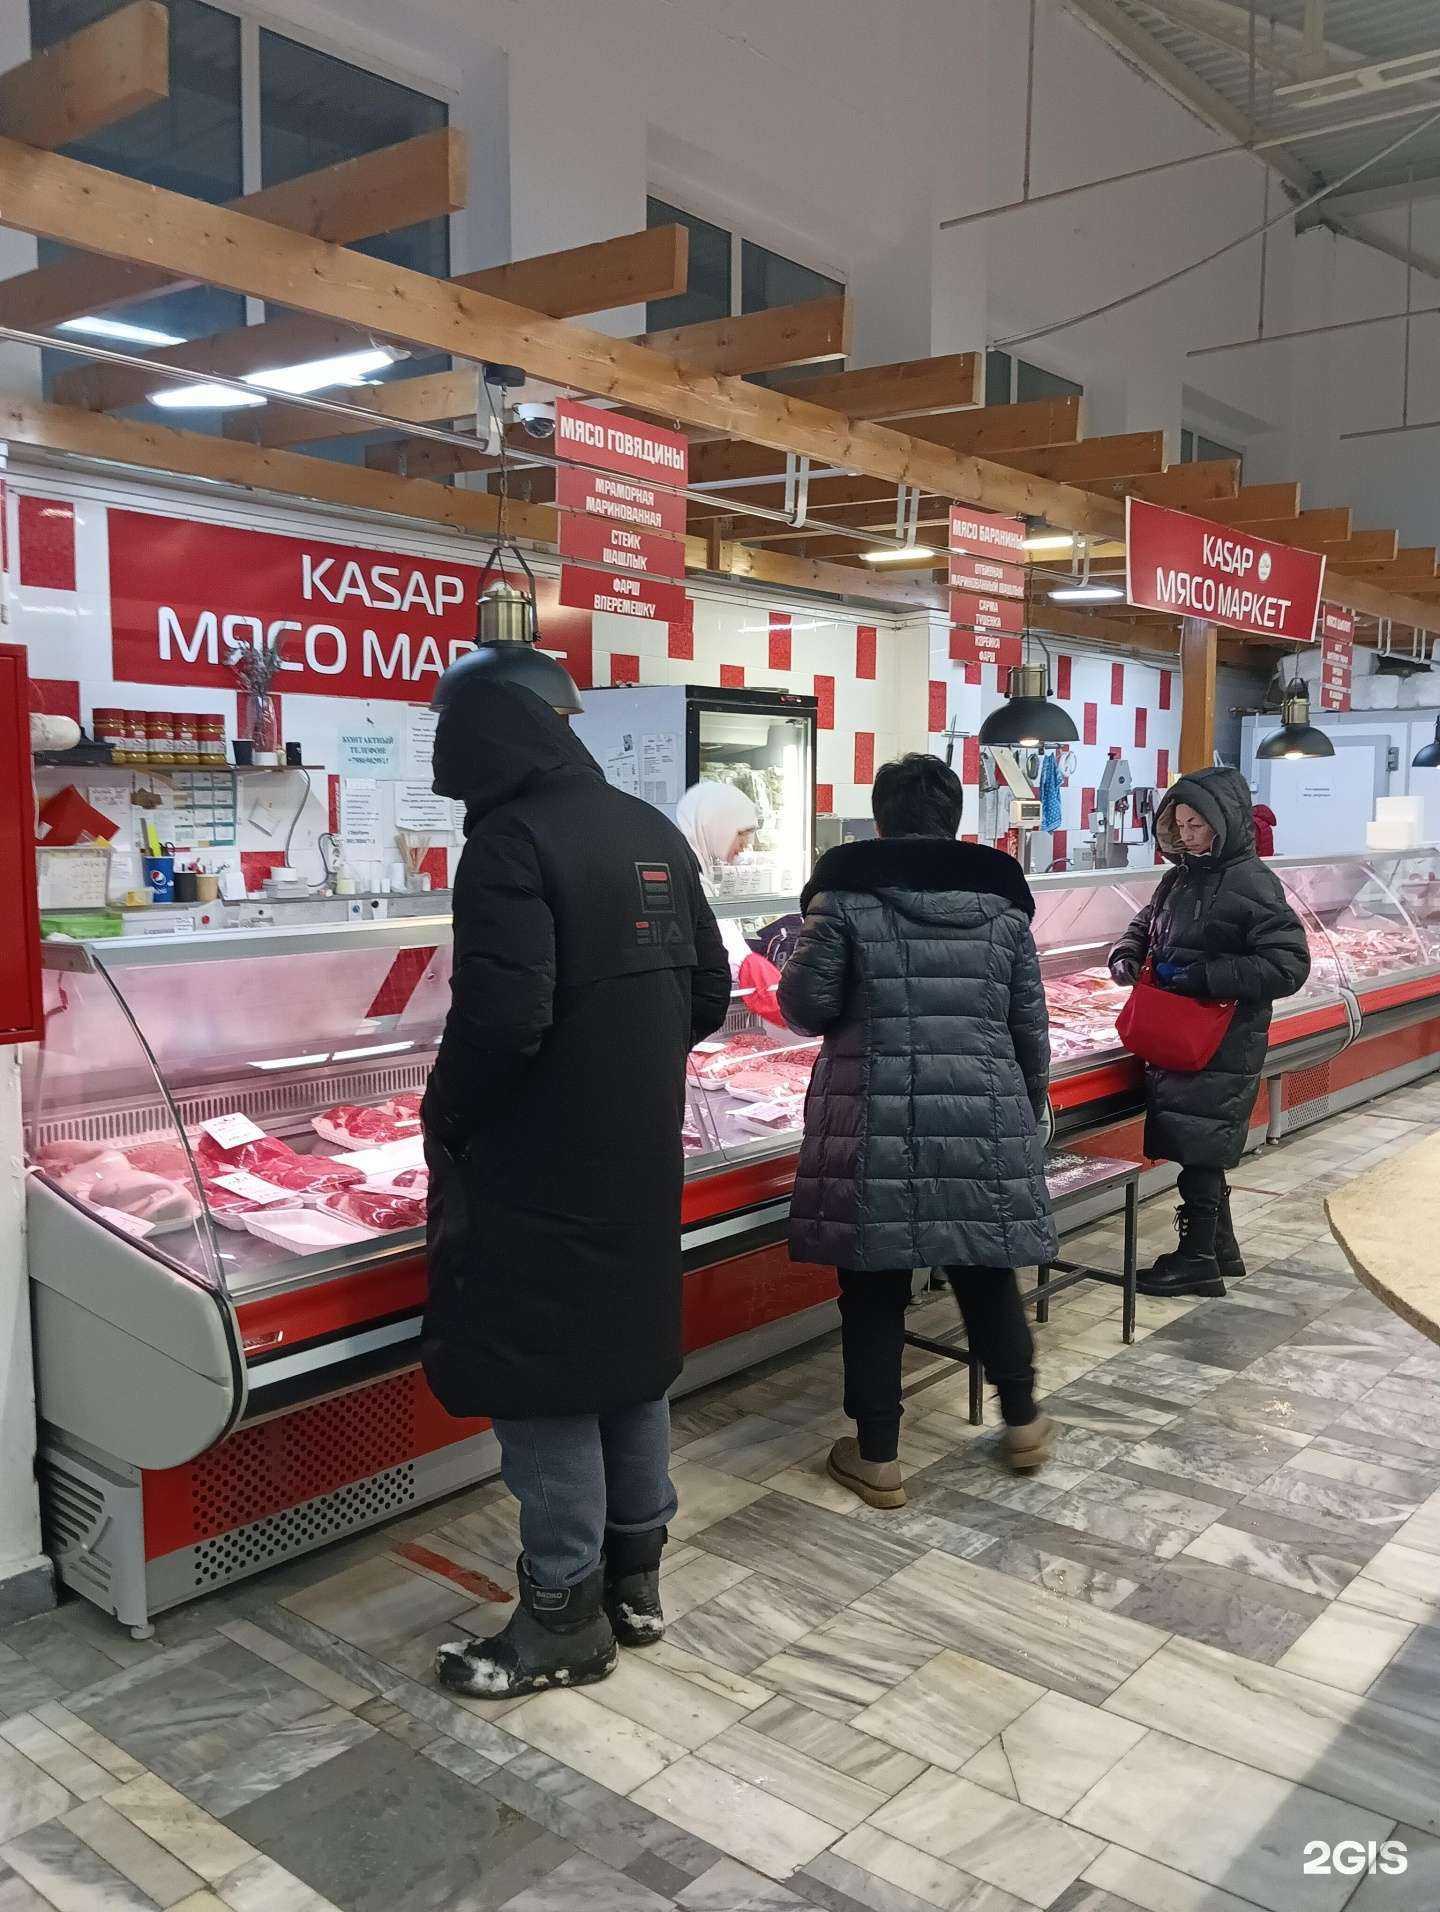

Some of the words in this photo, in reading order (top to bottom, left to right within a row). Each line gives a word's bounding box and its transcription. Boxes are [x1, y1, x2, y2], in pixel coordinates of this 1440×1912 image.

[560, 415, 604, 449] МЯСО
[607, 429, 685, 471] ГОВЯДИНЫ
[595, 477, 655, 507] МРАМОРНАЯ
[585, 496, 662, 528] МАРИНОВАННАЯ
[611, 529, 641, 550] СТЕЙК
[952, 519, 977, 540] МЯСО
[979, 524, 1024, 549] БАРАНИНЫ
[602, 547, 648, 571] ШАШЛЫК
[1202, 533, 1254, 577] KASAP
[301, 553, 465, 616] KASAP
[612, 578, 641, 596] ФАРШ
[1156, 566, 1216, 612] МЯСО
[1217, 582, 1292, 630] МАРКЕТ
[593, 594, 656, 618] ВПЕРЕМЕШКУ
[157, 605, 348, 675] МЯСО
